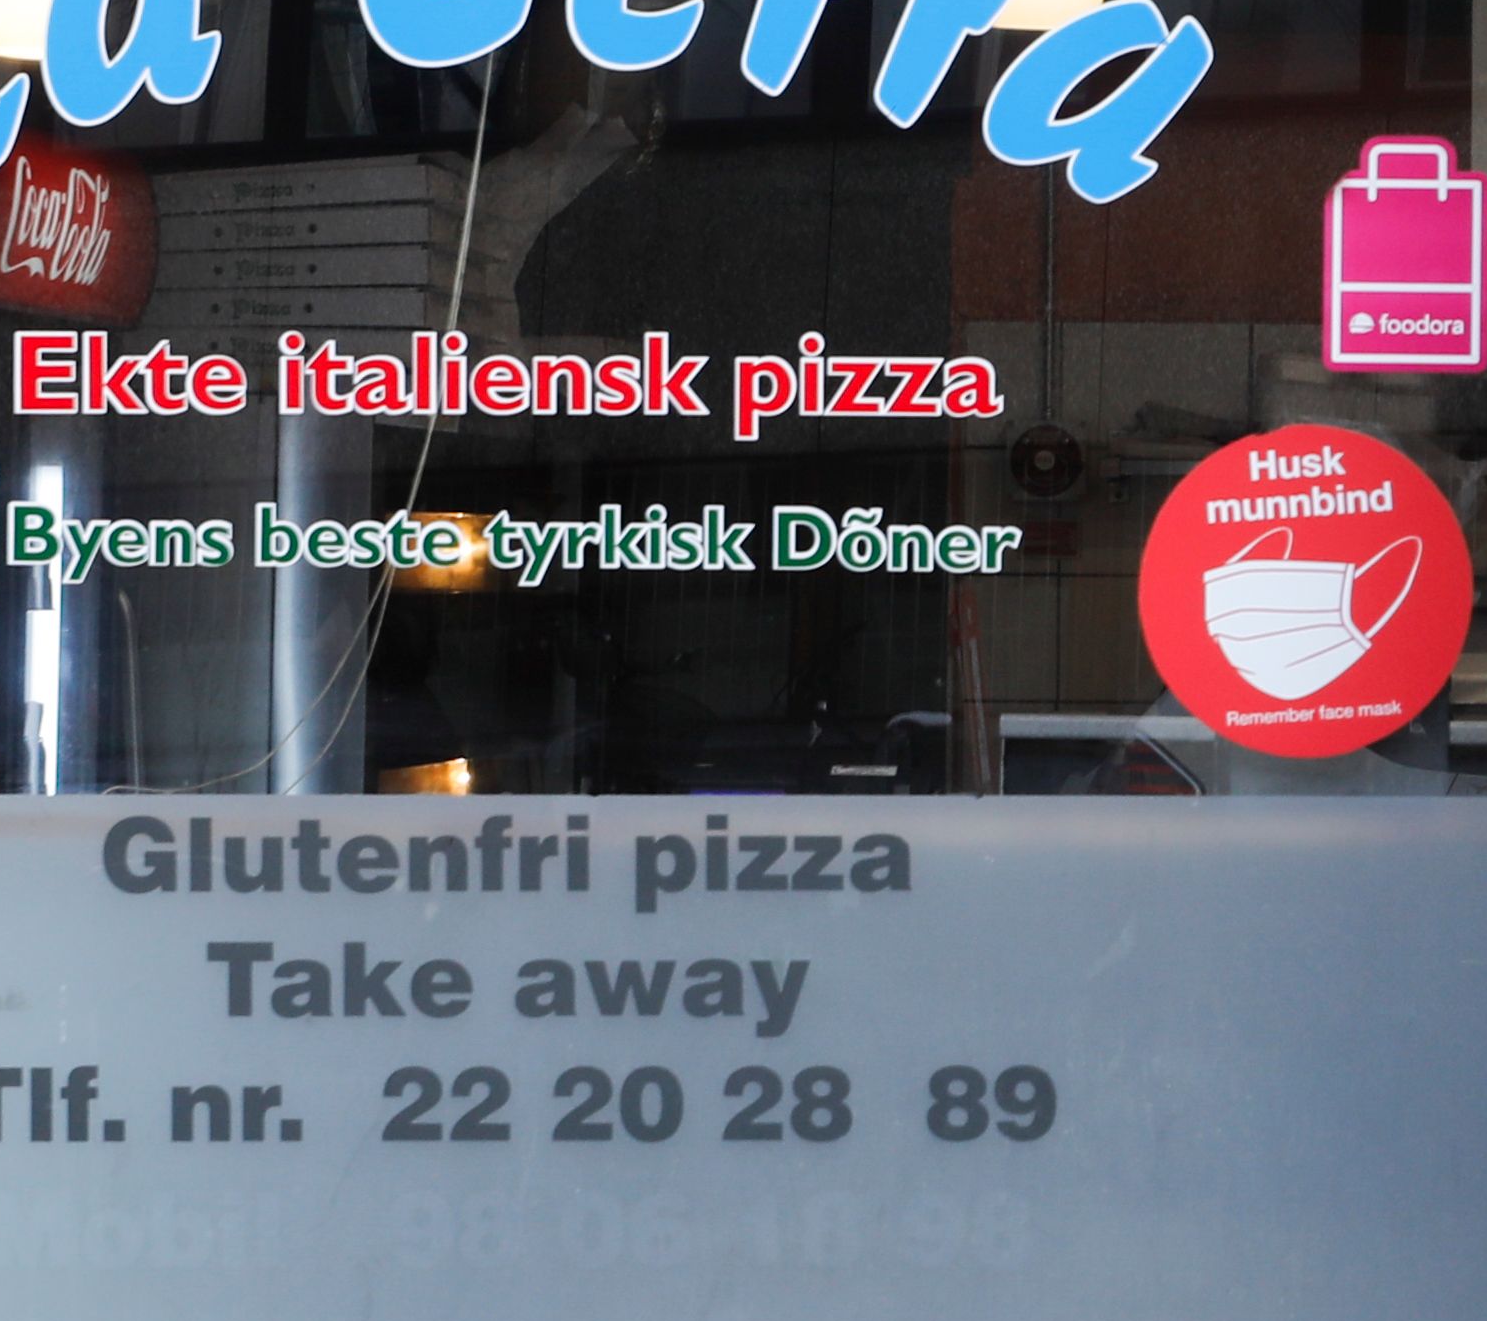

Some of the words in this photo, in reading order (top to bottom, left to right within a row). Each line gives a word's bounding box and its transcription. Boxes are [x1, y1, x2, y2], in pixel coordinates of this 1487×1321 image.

[0, 155, 111, 286] Coca-Cola
[1378, 312, 1465, 338] foodora
[12, 329, 248, 417] Ekte
[277, 329, 710, 418] italiensk
[731, 330, 1005, 442] pizza
[1205, 480, 1395, 525] munnbind
[1248, 445, 1347, 483] Husk
[6, 500, 235, 585] Byens
[253, 501, 477, 571] beste
[487, 504, 754, 588] tyrkisk
[1225, 704, 1317, 728] Remember
[1318, 702, 1355, 722] face
[1357, 698, 1403, 720] mask
[101, 814, 591, 895] Glutenfri
[633, 814, 912, 914] pizza
[206, 941, 474, 1020] Take
[514, 956, 811, 1038] away
[171, 1081, 304, 1144] nr.
[380, 1064, 511, 1144] 22
[551, 1064, 686, 1144] 20
[721, 1064, 853, 1144] 28
[925, 1063, 1058, 1144] 89
